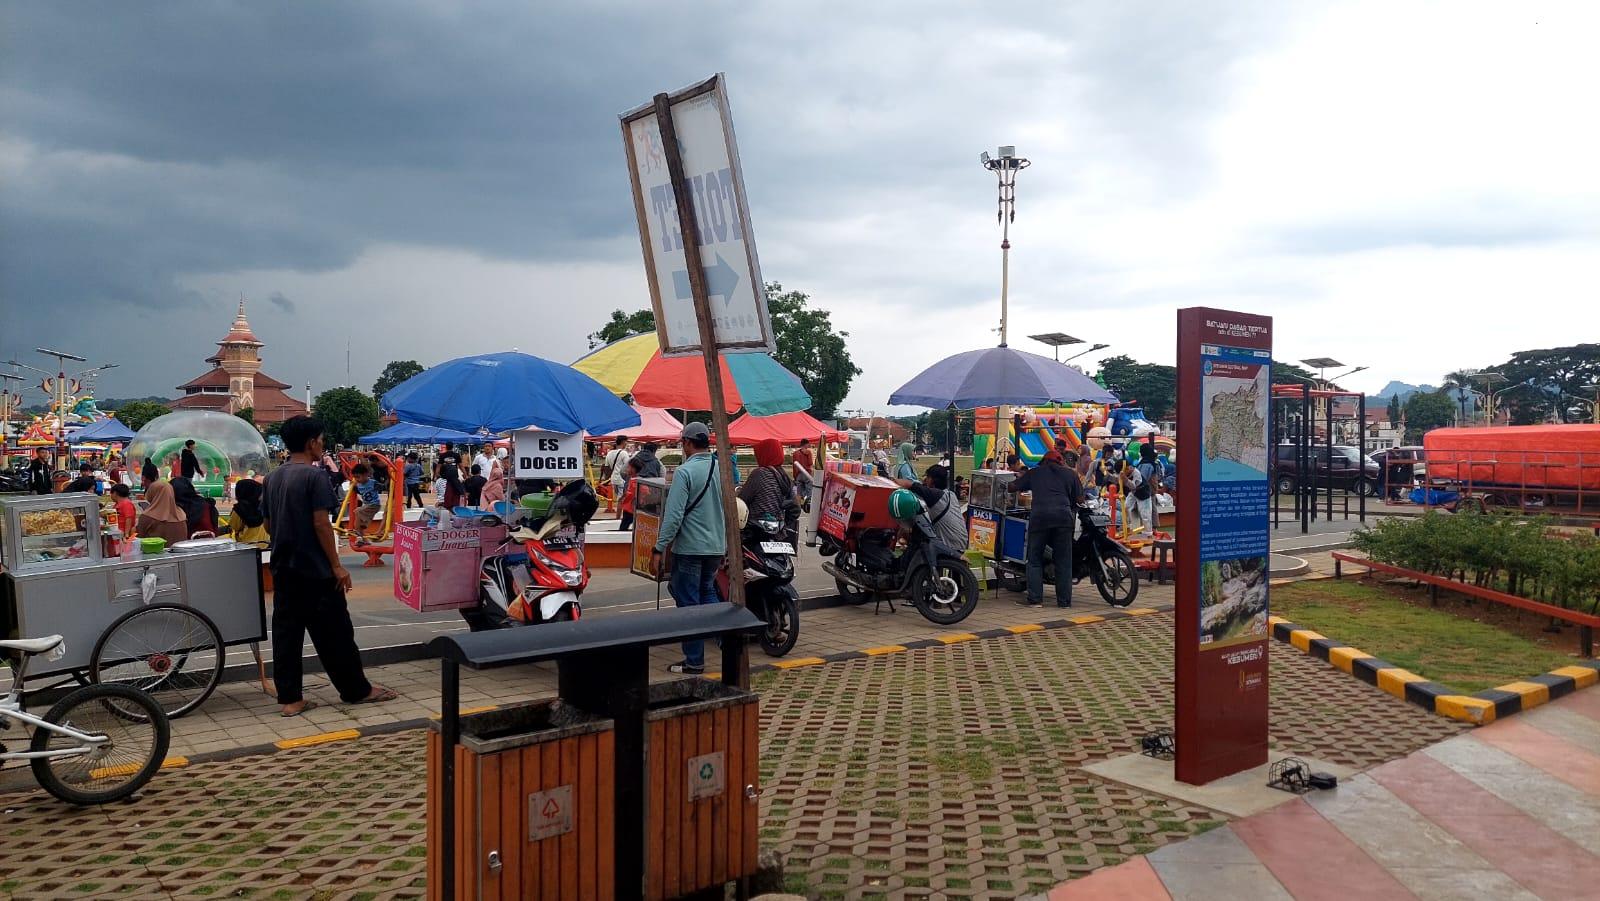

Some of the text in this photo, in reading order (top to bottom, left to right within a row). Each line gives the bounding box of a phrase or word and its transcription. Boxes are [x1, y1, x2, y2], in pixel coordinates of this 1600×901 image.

[538, 438, 559, 452] ES
[520, 456, 578, 470] DOGER
[427, 529, 480, 541] ES DOGER
[438, 540, 468, 551] Juara
